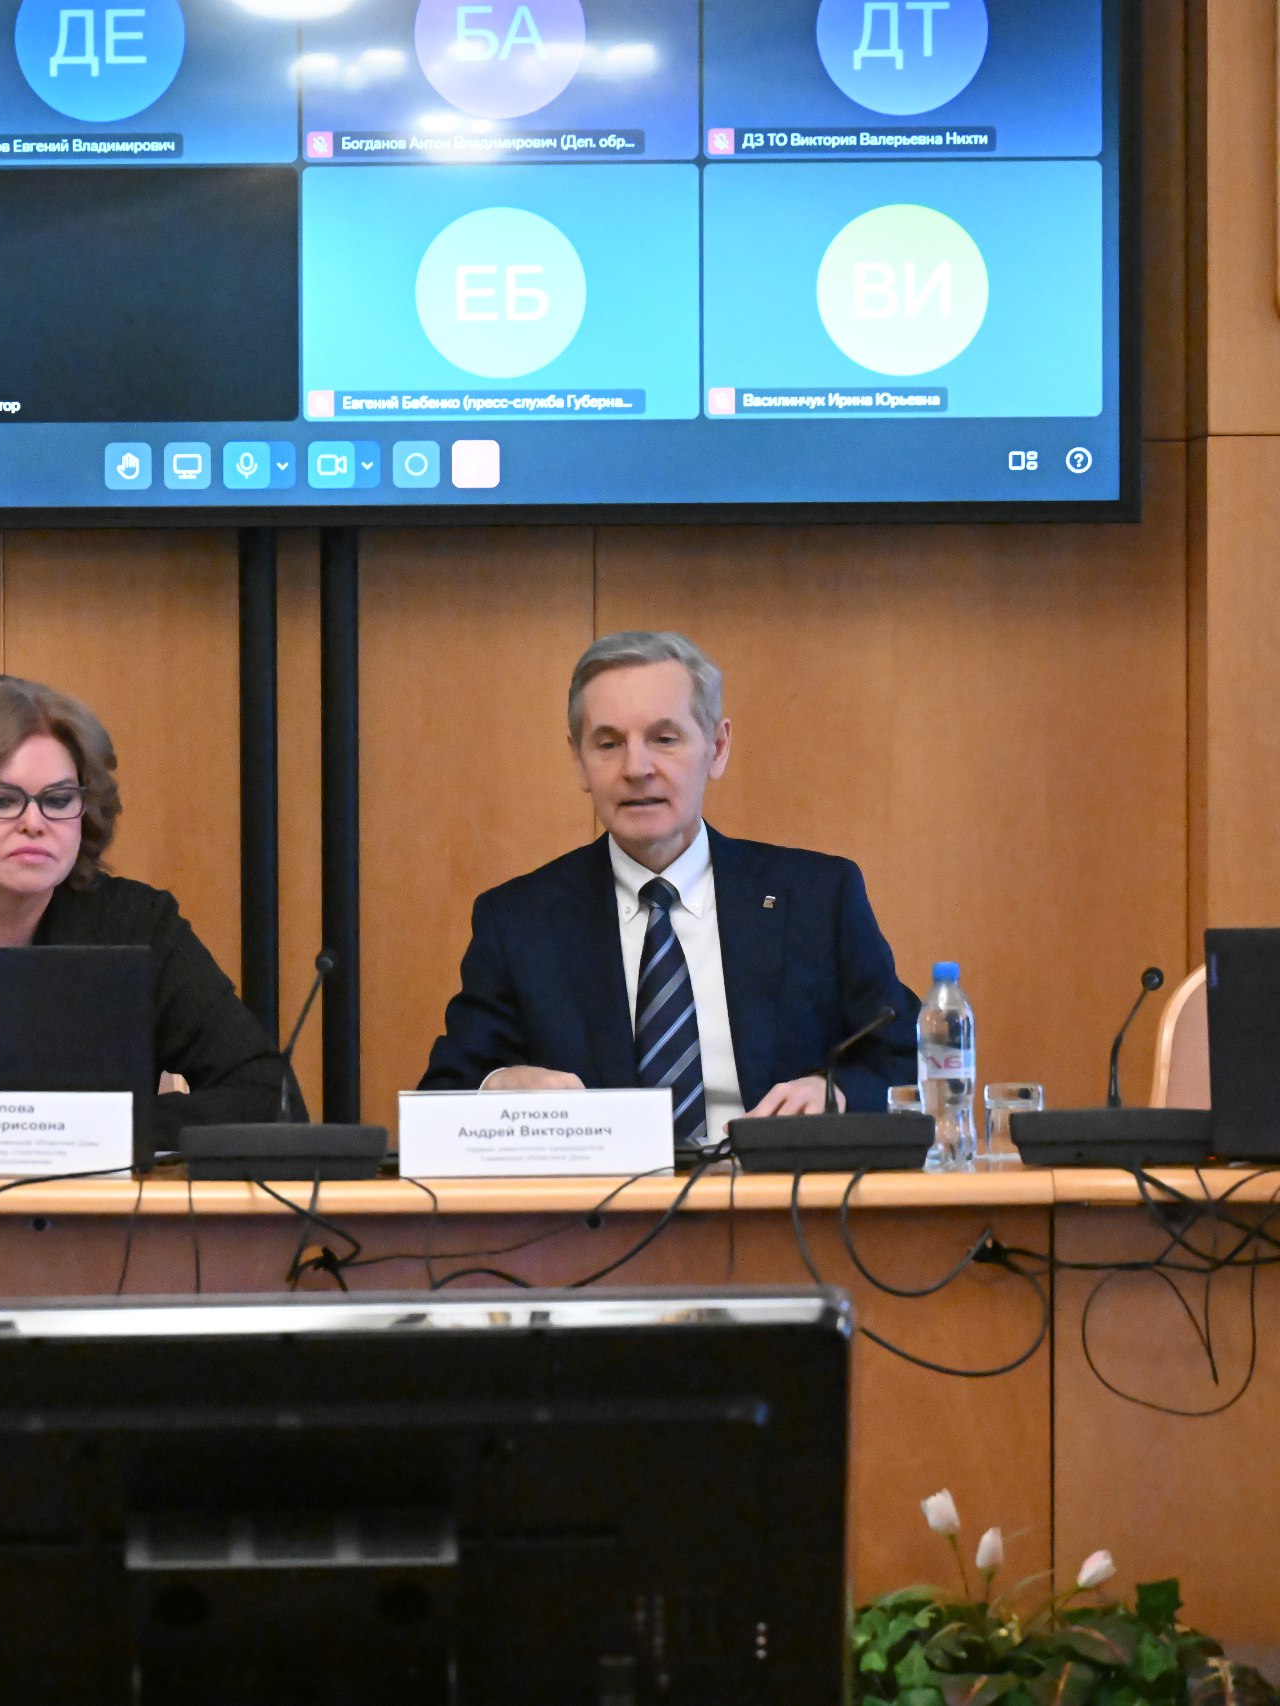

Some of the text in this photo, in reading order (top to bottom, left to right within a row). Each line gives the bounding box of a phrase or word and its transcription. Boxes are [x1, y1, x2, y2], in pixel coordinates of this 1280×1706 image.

[455, 5, 548, 61] БА
[853, 2, 949, 69] ДТ
[49, 9, 147, 77] ДЕ
[13, 139, 69, 153] Евгений
[72, 139, 175, 155] Владимирович
[341, 136, 406, 152] Богданов
[409, 136, 452, 150] Антон
[454, 136, 557, 151] Владимирович
[560, 134, 596, 150] (Деп.
[769, 133, 788, 147] ТО
[790, 133, 857, 148] Виктория
[859, 132, 942, 148] Валерьевна
[946, 132, 988, 145] Нихти
[455, 265, 549, 322] ЕБ
[853, 262, 952, 318] ВИ
[342, 395, 399, 410] Евгений
[402, 395, 460, 410] Бабенко
[463, 394, 564, 411] (пресс-служба
[742, 392, 941, 410] Василинчук Ирина Юрьевна
[500, 1108, 569, 1121] Артюхов
[458, 1125, 612, 1139] Андрей Викторович
